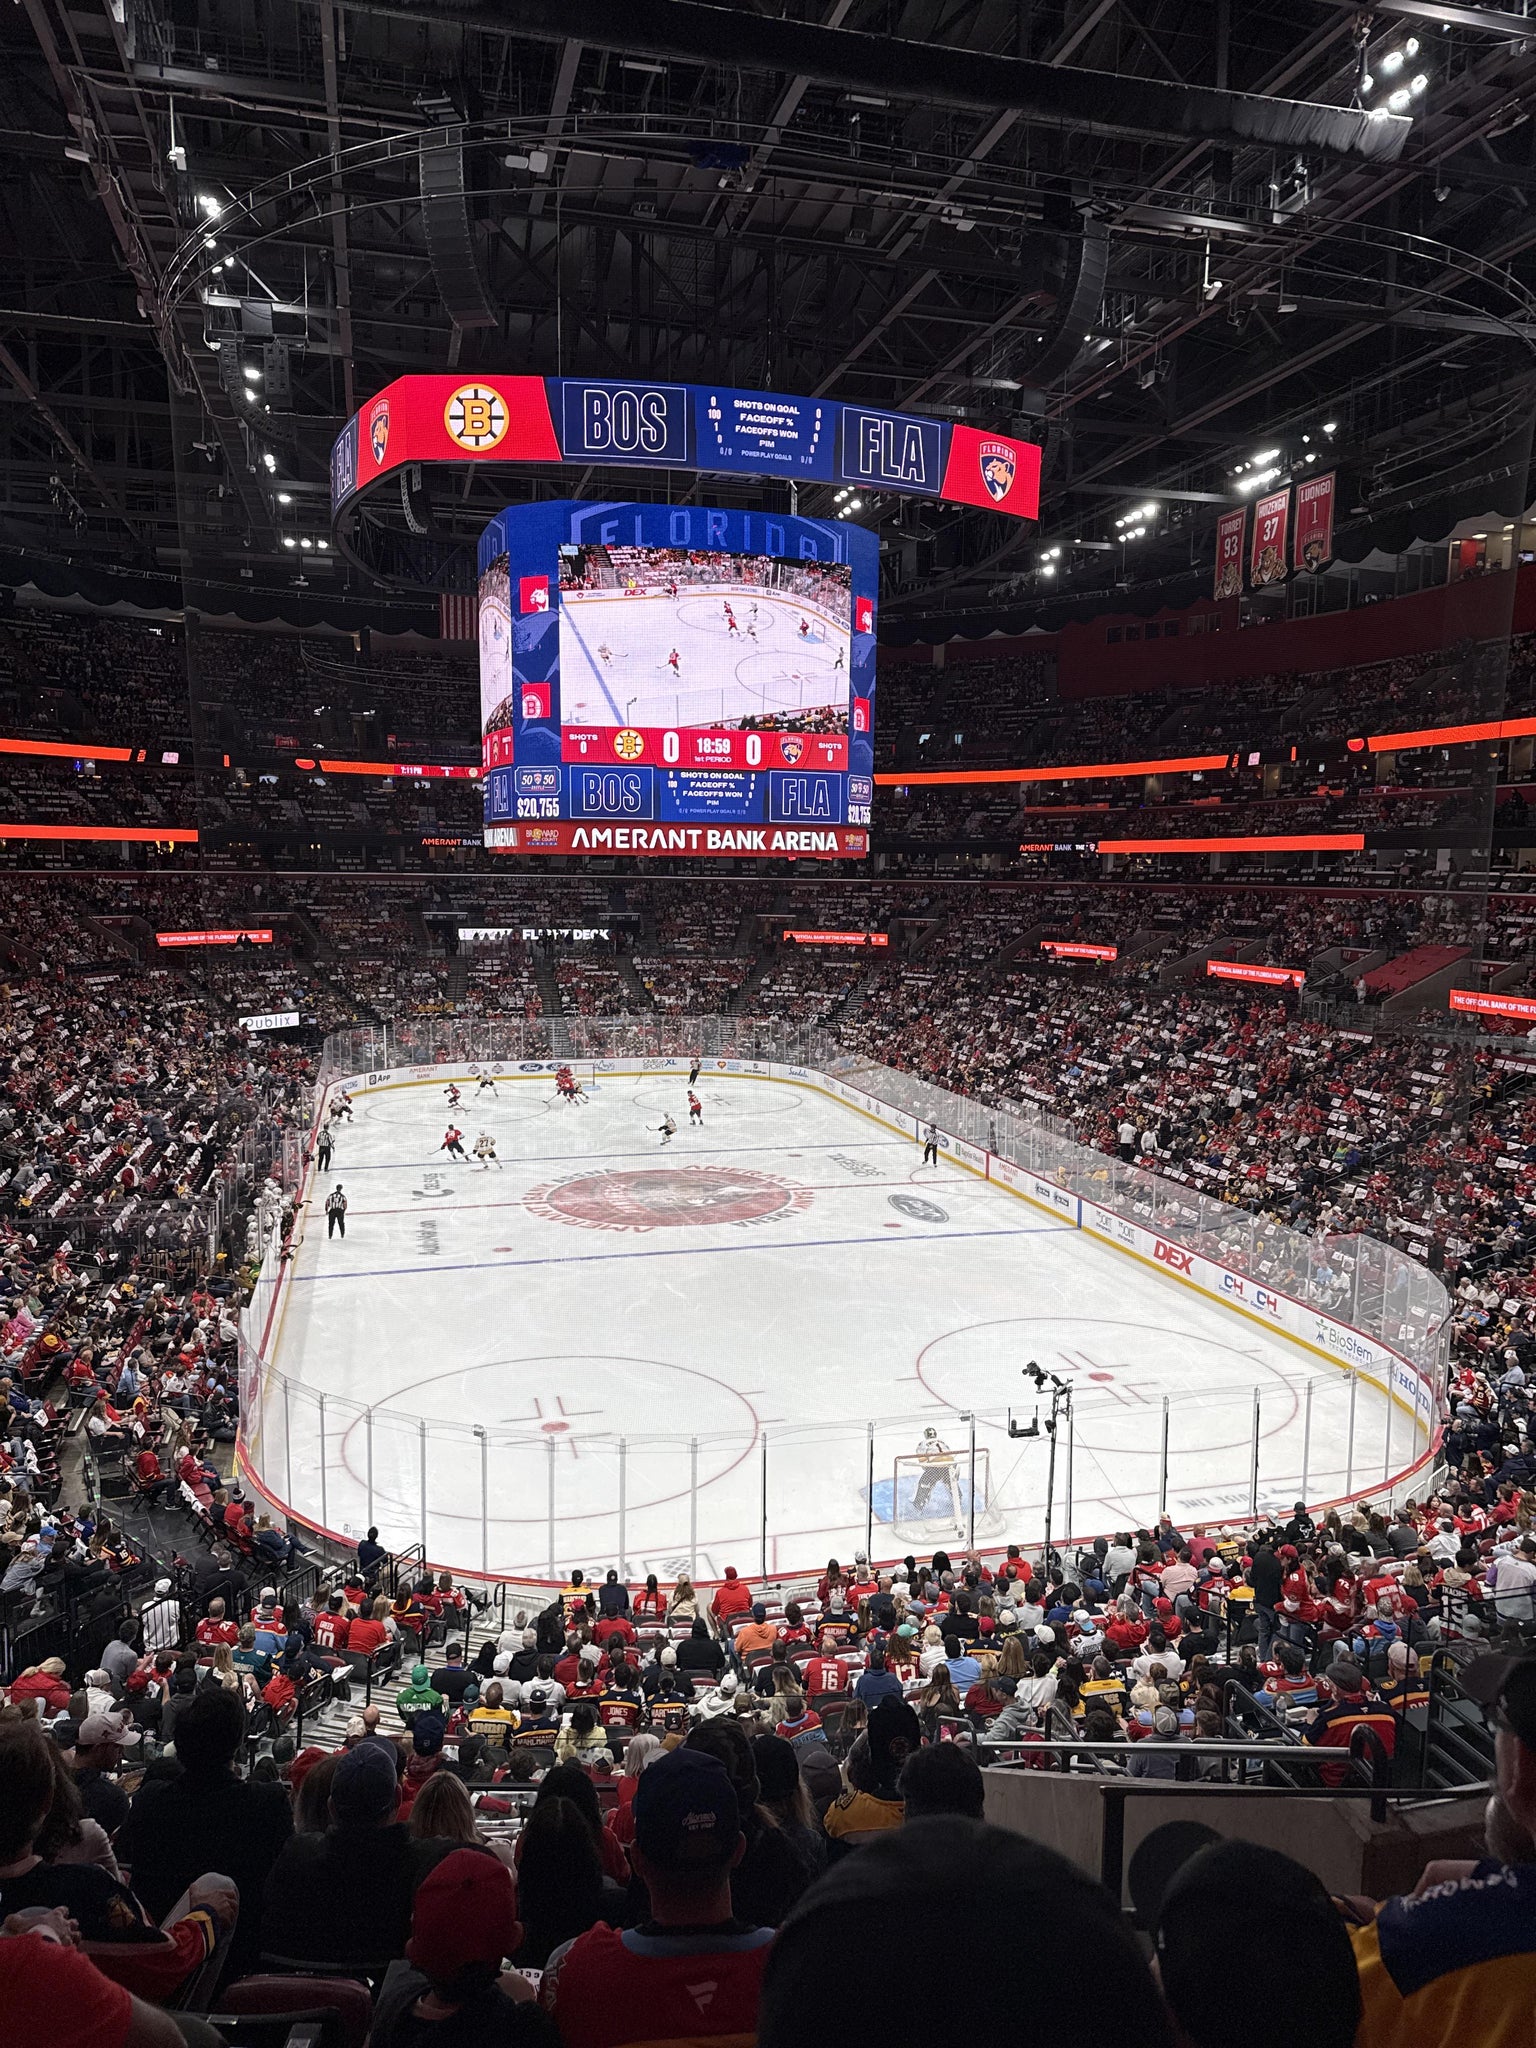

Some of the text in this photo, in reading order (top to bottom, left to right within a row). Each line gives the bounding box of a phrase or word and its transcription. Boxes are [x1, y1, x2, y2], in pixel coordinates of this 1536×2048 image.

[708, 409, 721, 419] 100
[733, 399, 800, 415] SHOTS ON GOAL
[584, 390, 667, 452] BOS
[714, 422, 718, 432] 1
[740, 413, 785, 425] FACEOFF
[735, 425, 799, 439] FACEOFFS WON
[759, 439, 775, 448] PIM
[860, 416, 926, 483] FLA
[982, 443, 1016, 461] FLORIDA
[760, 451, 774, 459] PLAY
[1301, 479, 1331, 503] LUONGO
[1258, 496, 1286, 519] HUIZENGA
[1311, 501, 1319, 524] 1
[1221, 516, 1243, 537] TORREY
[1263, 516, 1279, 542] 37
[600, 510, 818, 562] FLORIDA
[1224, 535, 1239, 559] 93
[624, 588, 647, 597] DEX
[569, 733, 598, 741] SHOTS
[696, 737, 731, 754] 18:59
[580, 741, 587, 754] 0
[663, 731, 680, 763] 0
[745, 734, 762, 766] 0
[818, 742, 842, 750] SHOTS
[827, 749, 833, 762] 0
[521, 774, 555, 785] 50 50
[690, 781, 728, 789] FACEOFF
[493, 774, 509, 813] FLA
[582, 772, 642, 813] BOS
[782, 778, 830, 816] FLA
[851, 783, 858, 793] 50
[862, 785, 870, 794] 50
[517, 797, 560, 819] $20,755
[421, 838, 461, 846] AMERANT
[571, 828, 702, 850] AMERANT
[707, 830, 767, 850] BANK
[770, 831, 838, 851] ARENA
[1453, 996, 1465, 1004] THE
[1491, 1001, 1507, 1010] BANK
[1517, 1004, 1530, 1012] THE
[665, 1058, 677, 1066] XL
[378, 1074, 391, 1082] App
[480, 1140, 488, 1148] 27
[1153, 1240, 1195, 1276] DEX
[1224, 1274, 1244, 1295] CH
[1256, 1290, 1277, 1312] CH
[1329, 1328, 1373, 1363] BioStem
[320, 1621, 335, 1630] GREER
[824, 1627, 847, 1635] MARCHAND
[317, 1629, 335, 1648] 10
[822, 1670, 839, 1690] 16
[608, 1707, 628, 1716] JONES
